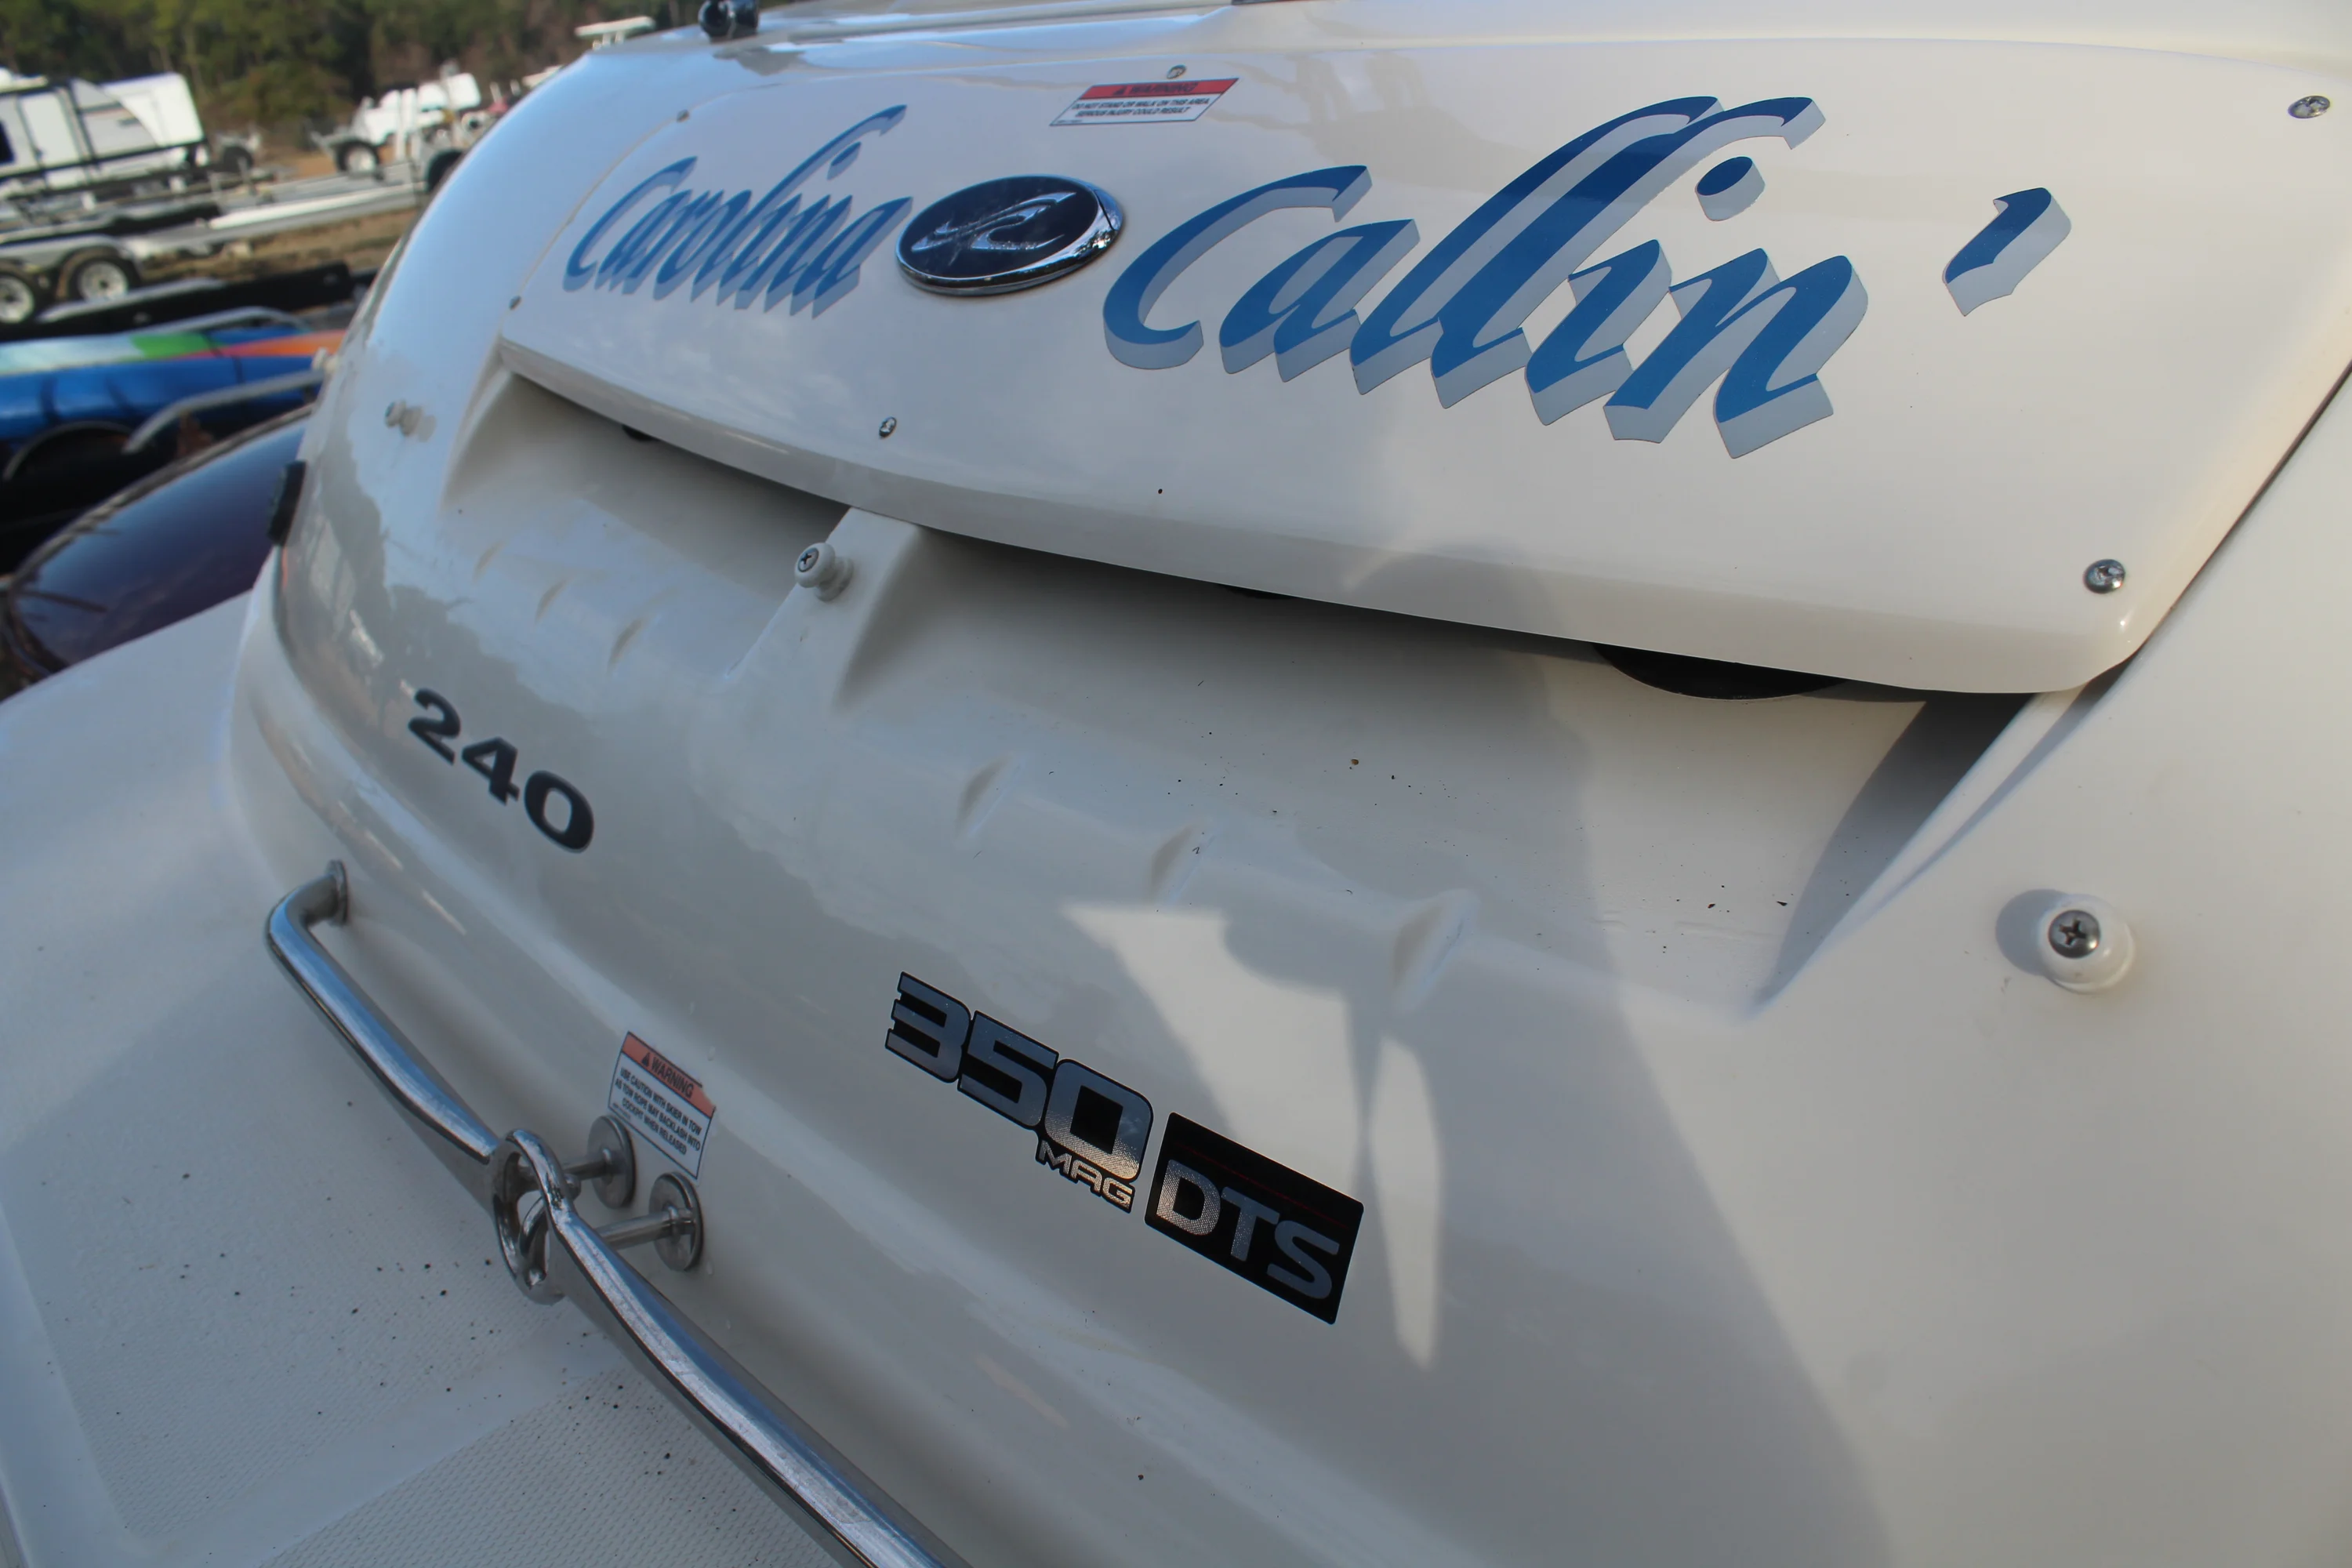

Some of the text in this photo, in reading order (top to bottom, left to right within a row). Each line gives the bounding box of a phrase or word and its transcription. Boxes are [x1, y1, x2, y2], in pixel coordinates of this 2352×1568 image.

[1128, 82, 1200, 94] WARNING
[562, 104, 914, 319] Carolina
[408, 688, 594, 854] 240
[620, 1067, 702, 1136] USE CAUTION WITH SKIER IN TOW
[652, 1058, 694, 1098] WARNING
[885, 971, 1154, 1180] 350
[615, 1079, 622, 1088] AS
[622, 1083, 633, 1098] TOW
[633, 1092, 647, 1109] ROPE
[648, 1103, 659, 1118] MAY
[659, 1112, 687, 1140] BACKLASH
[687, 1135, 701, 1152] INTO
[622, 1098, 644, 1119] COCKPIT
[644, 1115, 659, 1132] WHEN
[659, 1127, 687, 1154] RELEASED
[1036, 1139, 1135, 1214] MAG
[1156, 1159, 1340, 1299] DTS
